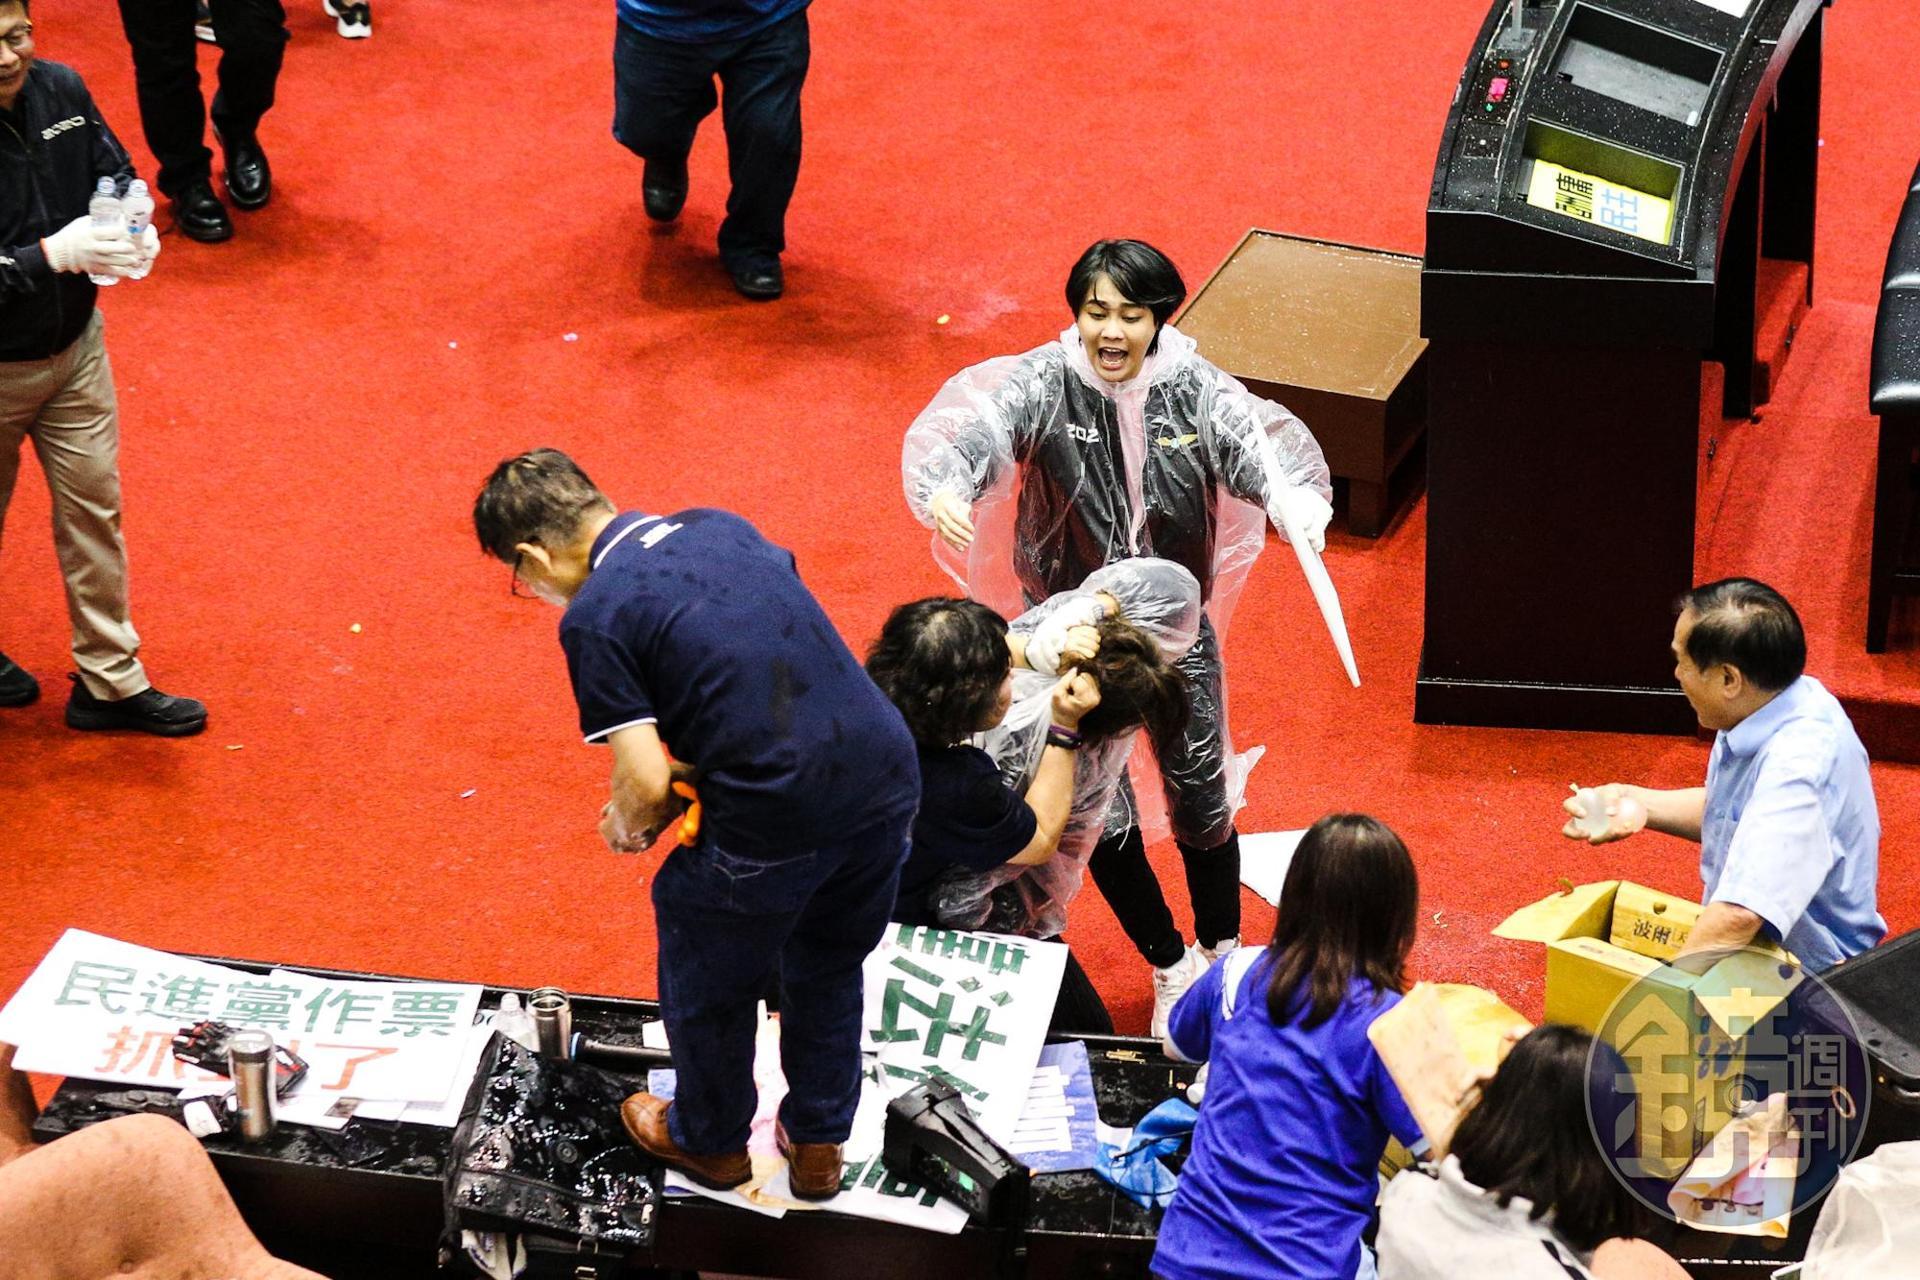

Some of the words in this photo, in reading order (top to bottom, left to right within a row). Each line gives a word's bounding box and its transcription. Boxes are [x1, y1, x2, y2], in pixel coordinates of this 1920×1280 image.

[1600, 188, 1638, 234] 民主
[1633, 919, 1671, 944] 波爾
[55, 960, 464, 1037] 民進黨作票
[94, 1025, 399, 1090] 抓了
